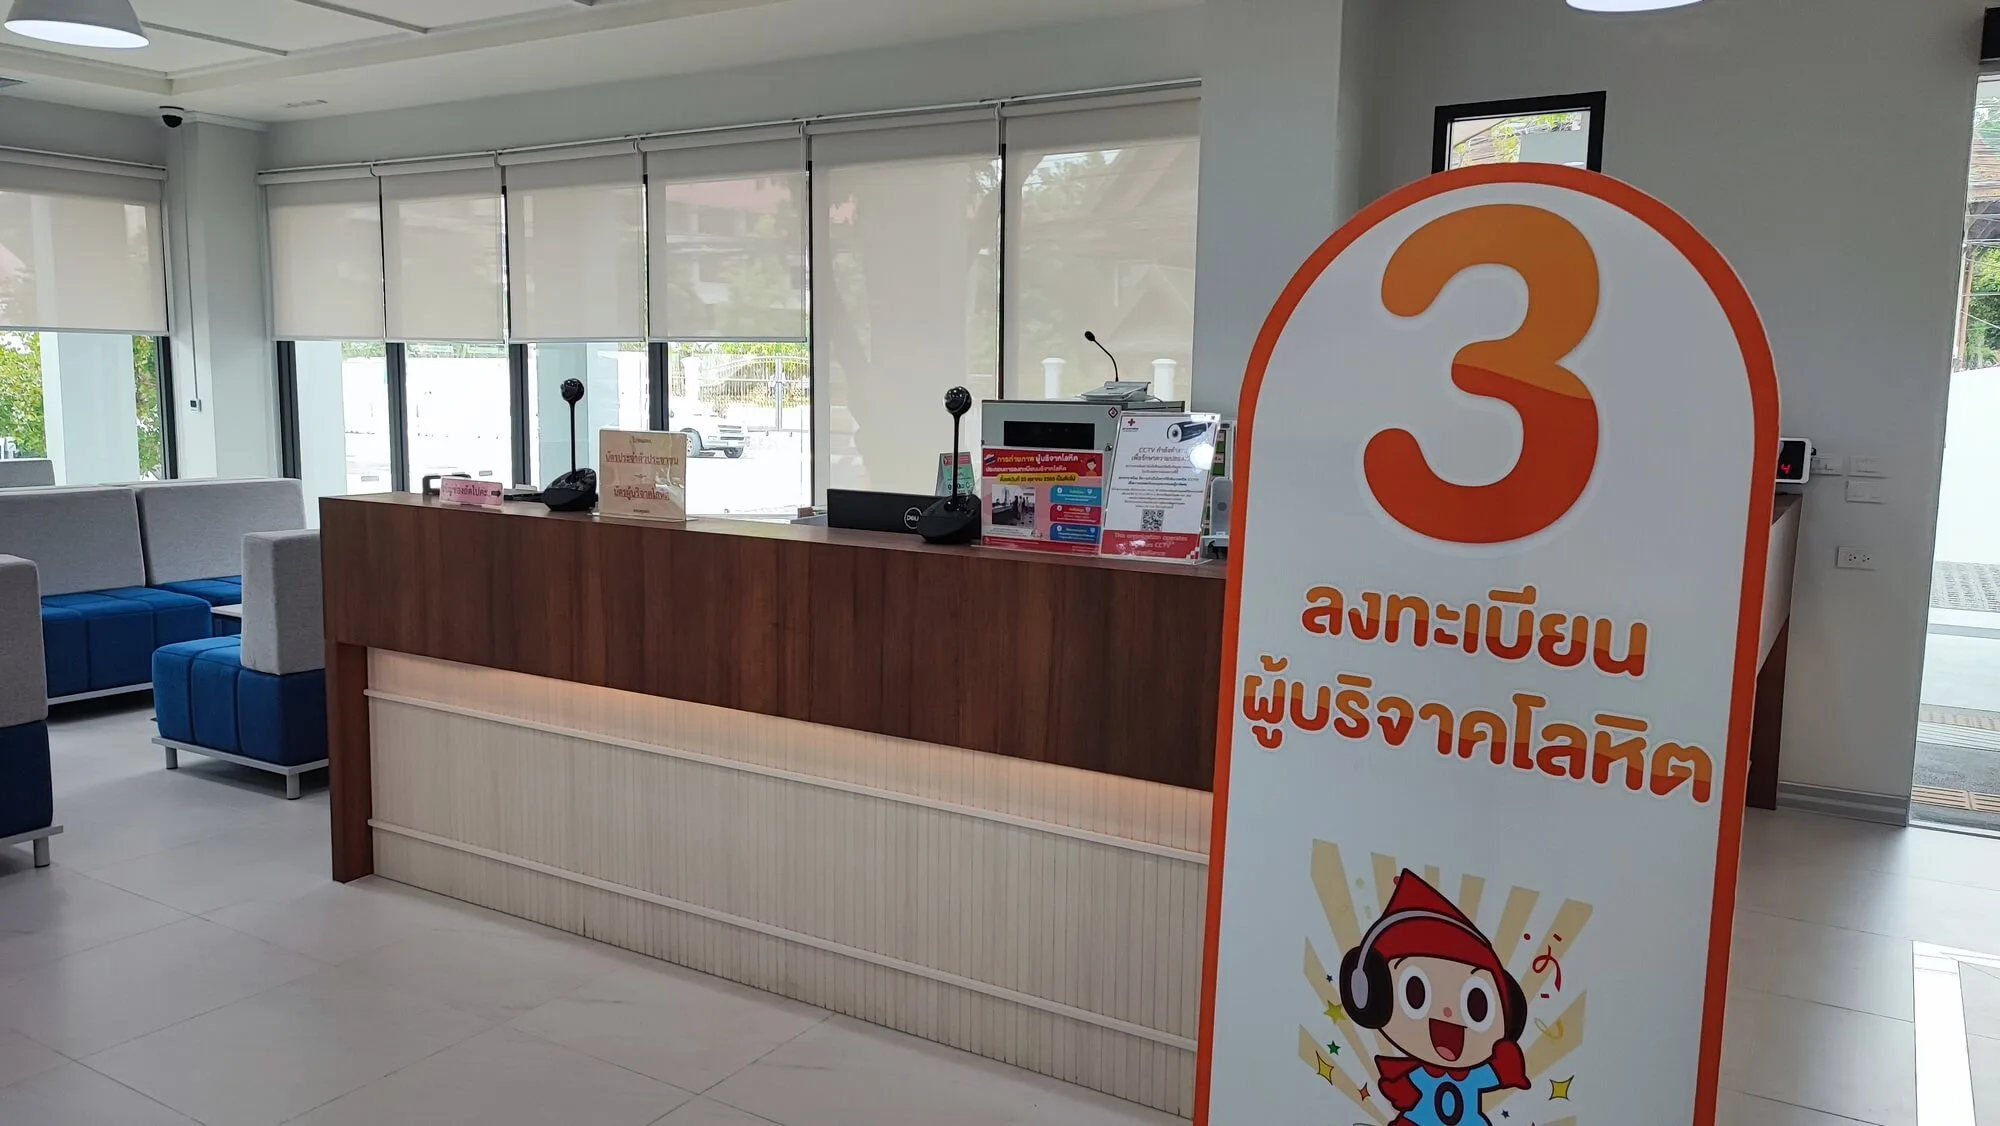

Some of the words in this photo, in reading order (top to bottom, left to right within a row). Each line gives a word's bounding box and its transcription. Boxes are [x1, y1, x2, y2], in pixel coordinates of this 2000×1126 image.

[1364, 203, 1599, 544] 3
[906, 514, 920, 522] DELL
[1301, 584, 1648, 678] ลงทะเบียน
[1241, 654, 1713, 804] ผู้บริจาคโลหิต
